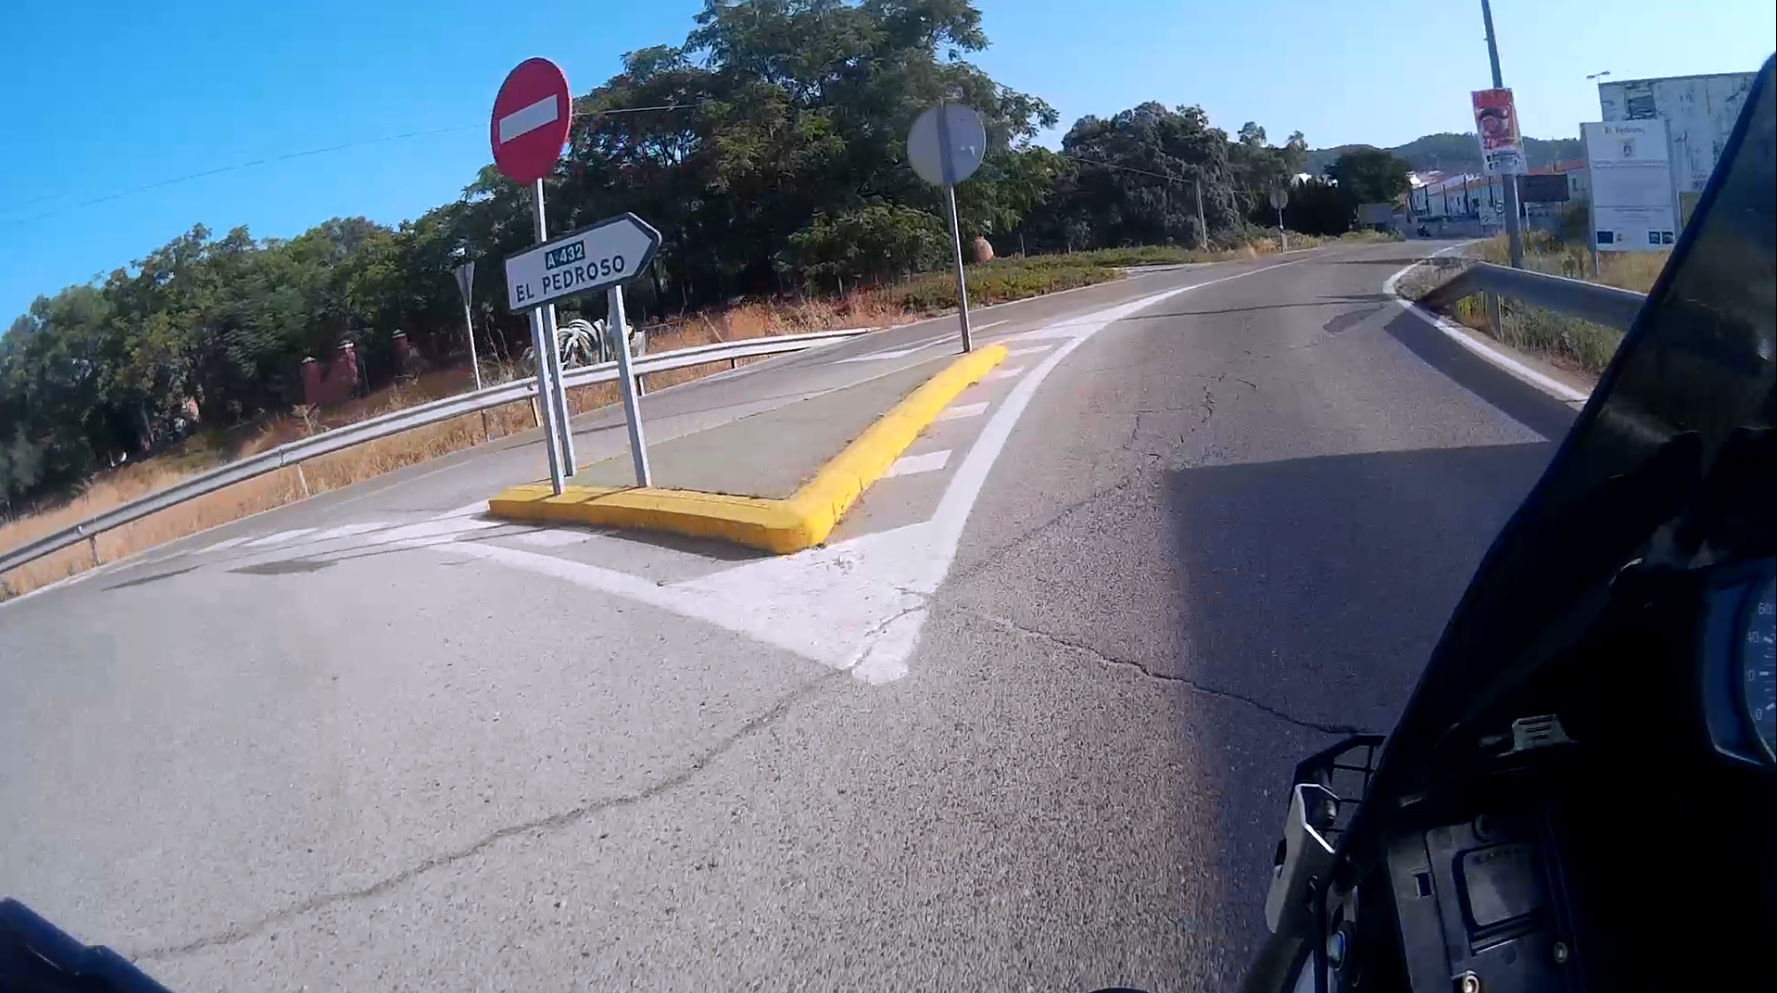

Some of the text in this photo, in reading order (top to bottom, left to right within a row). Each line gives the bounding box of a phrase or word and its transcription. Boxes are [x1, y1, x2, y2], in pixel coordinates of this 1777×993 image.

[547, 244, 583, 268] A 432
[515, 254, 625, 302] EL PEDROSO
